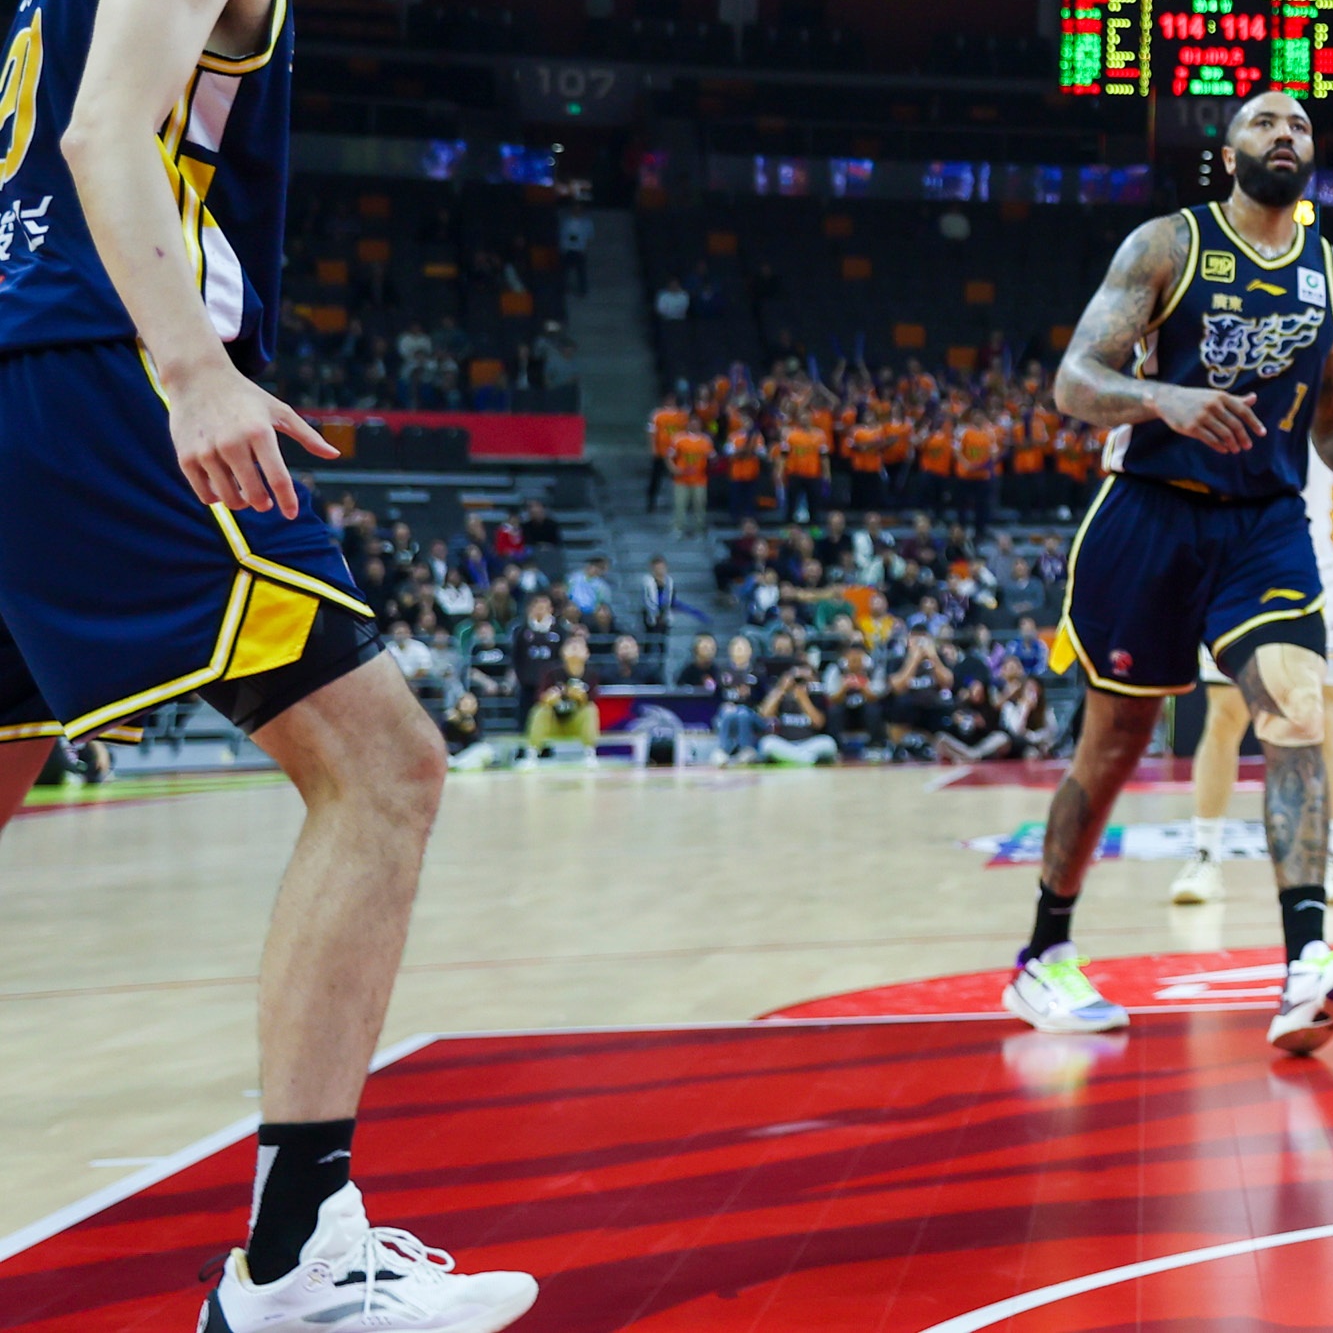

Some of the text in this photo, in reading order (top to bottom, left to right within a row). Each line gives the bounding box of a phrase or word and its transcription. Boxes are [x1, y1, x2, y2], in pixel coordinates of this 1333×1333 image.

[1158, 12, 1267, 41] 114 114
[537, 65, 616, 99] 107
[1212, 293, 1243, 312] 廣東
[1278, 382, 1308, 432] 1
